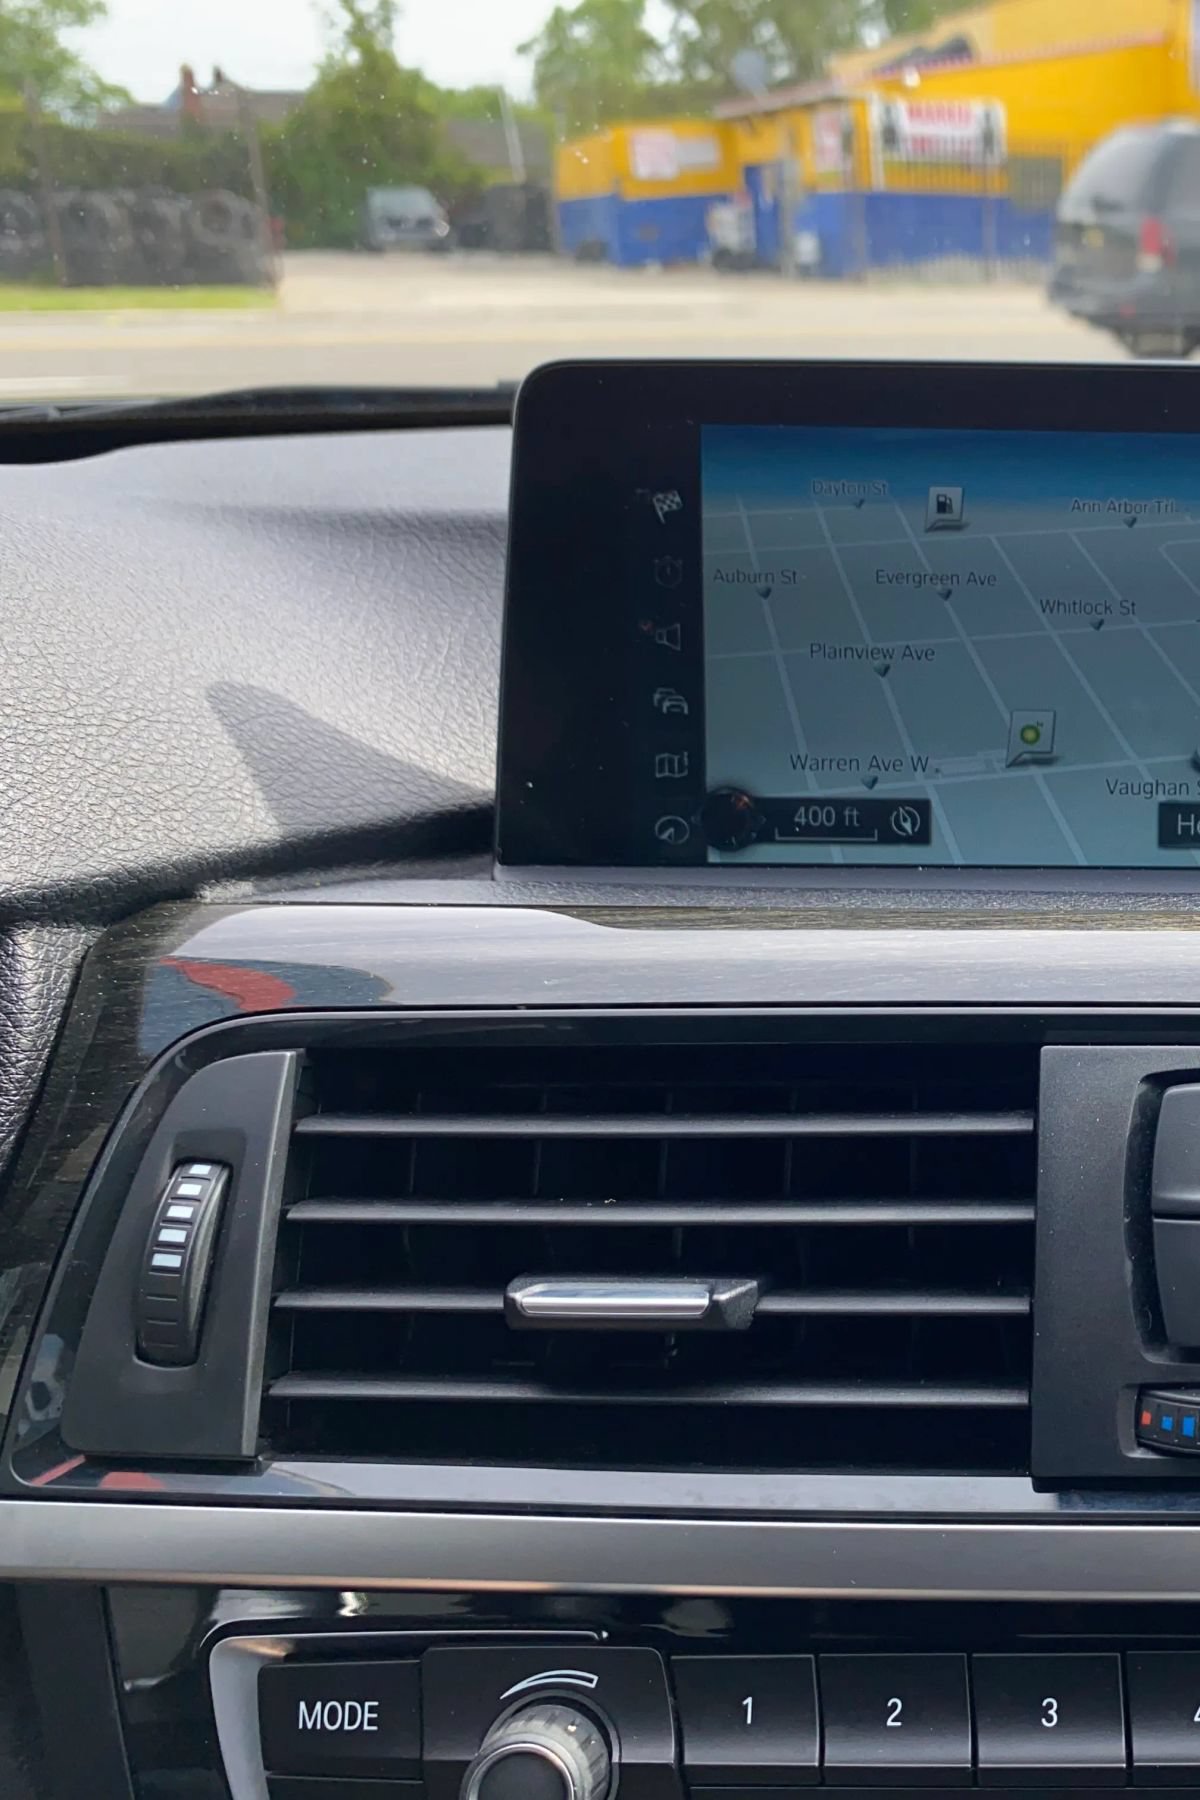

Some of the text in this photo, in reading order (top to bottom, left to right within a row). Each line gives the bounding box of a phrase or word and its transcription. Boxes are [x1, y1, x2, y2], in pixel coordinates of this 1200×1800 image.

[871, 480, 887, 497] St
[1071, 499, 1100, 513] Ann
[1106, 499, 1148, 514] Arbor
[713, 568, 798, 585] Auburn St
[875, 569, 997, 590] Evergreen Ave
[1039, 598, 1136, 616] Whitlock St
[810, 643, 935, 663] Plainview Ave
[789, 753, 929, 772] Warren Ave W
[1106, 778, 1189, 799] Vaughan
[793, 806, 861, 827] 400 ft
[298, 1701, 379, 1731] MODE
[742, 1697, 753, 1725] 1
[886, 1698, 902, 1727] 2
[1041, 1698, 1058, 1727] 3
